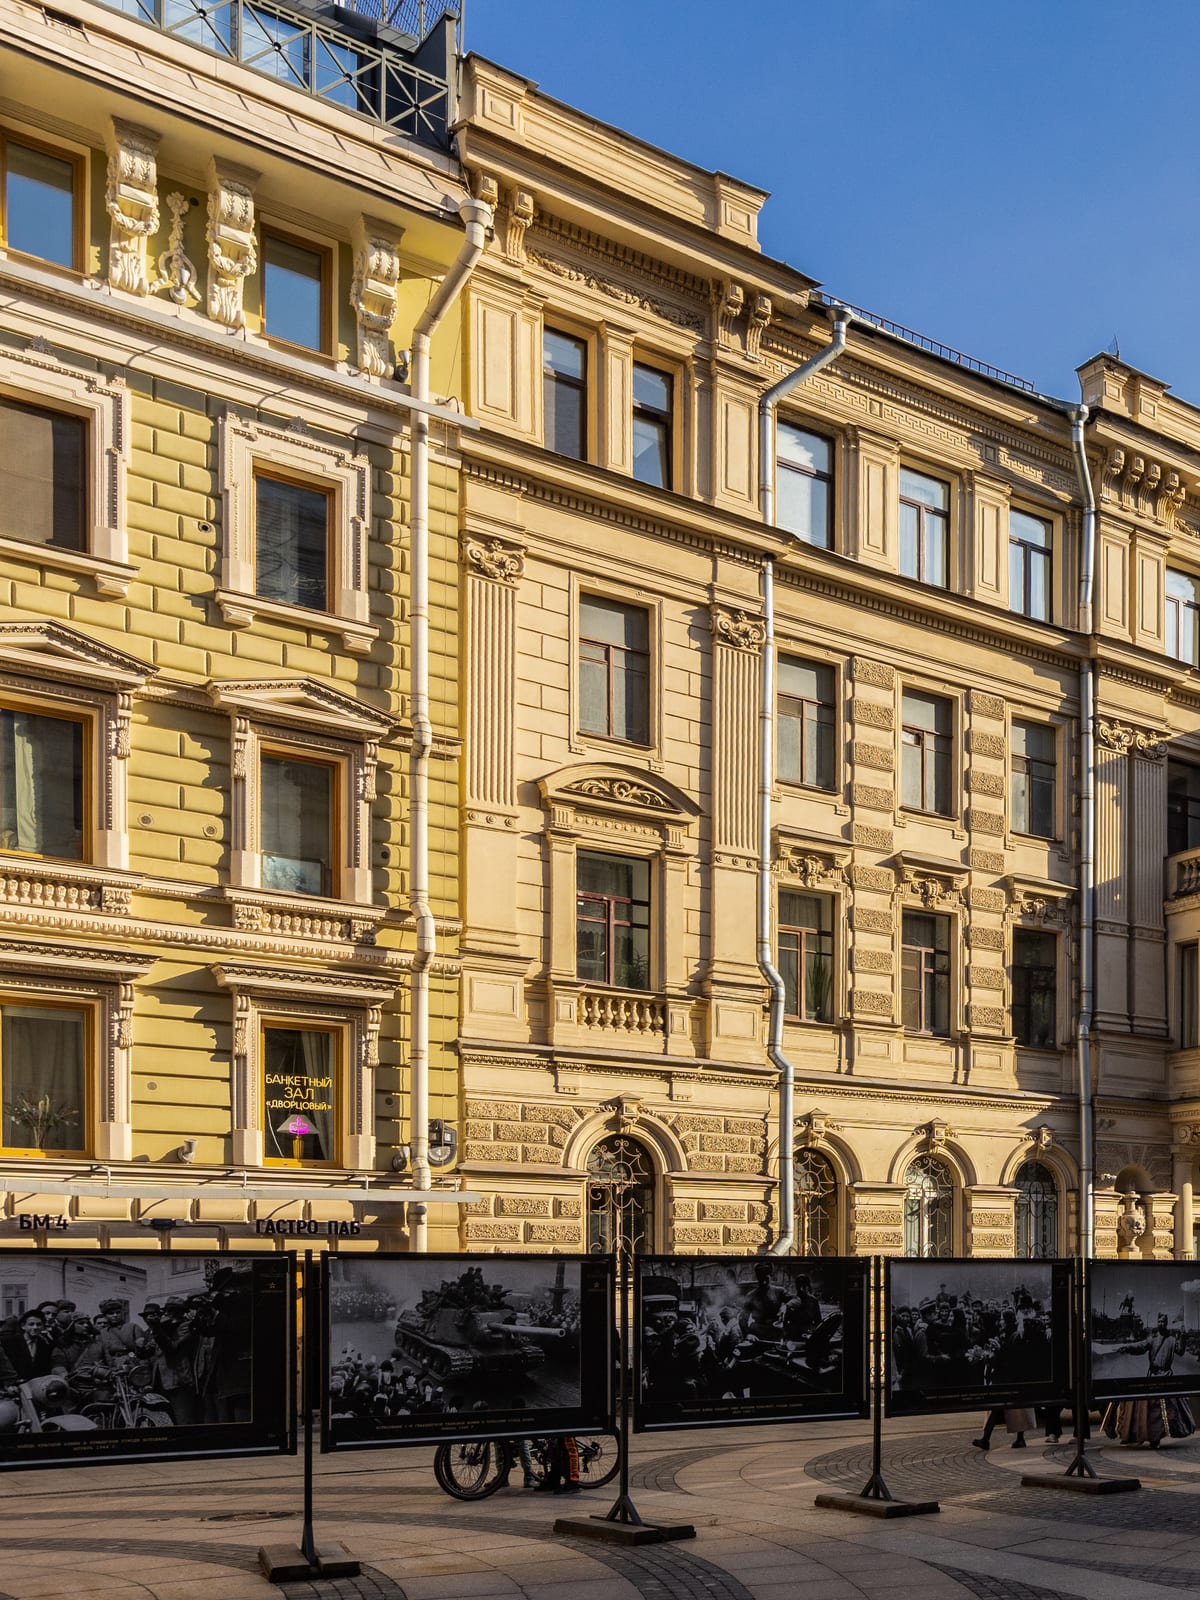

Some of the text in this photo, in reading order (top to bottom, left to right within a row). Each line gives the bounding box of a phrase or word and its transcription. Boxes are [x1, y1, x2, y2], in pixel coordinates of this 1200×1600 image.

[265, 1074, 332, 1088] БАНКЕТНЫЙ
[284, 1087, 315, 1100] ЗАЛ
[266, 1099, 332, 1111] «ДВОРЦОВЫЙ»
[20, 1213, 69, 1230] БМ 4
[255, 1219, 361, 1235] ГАСТРО ПАБ
